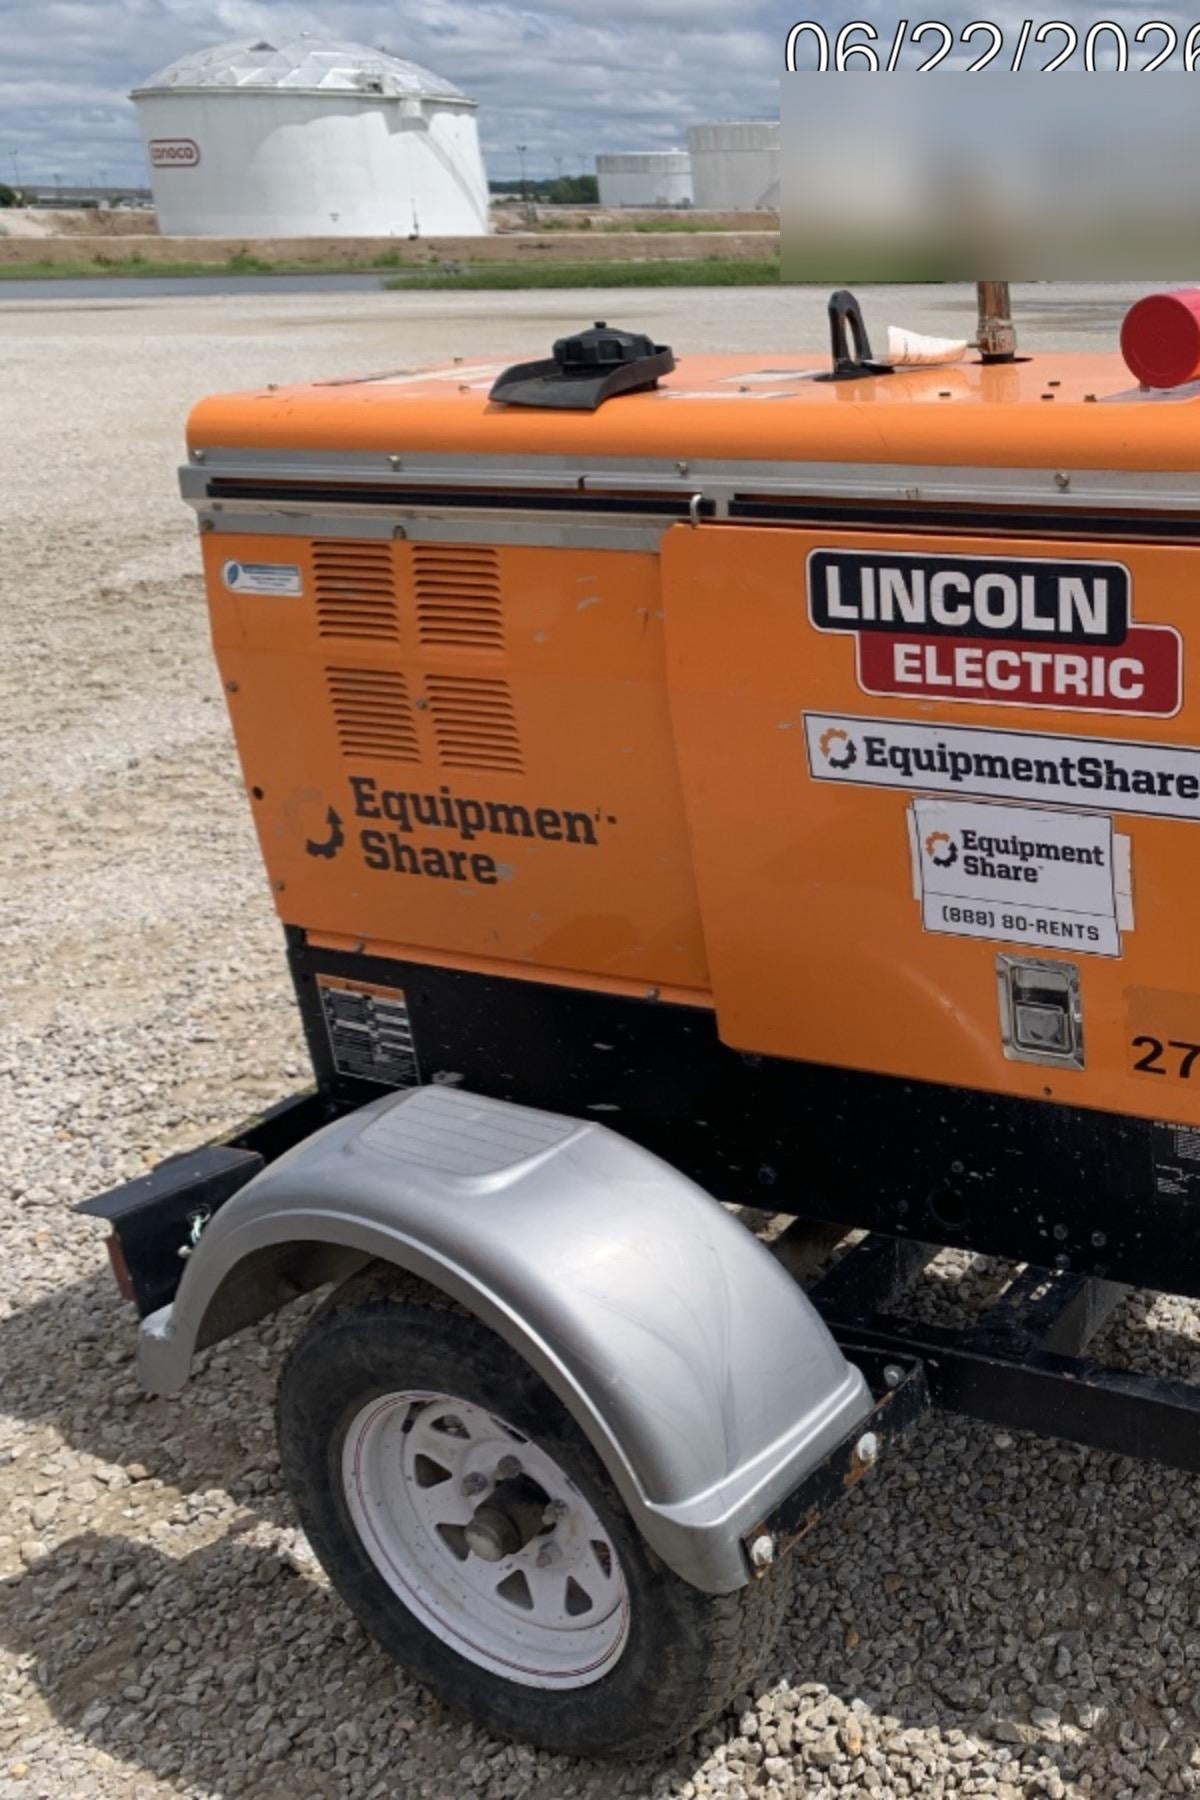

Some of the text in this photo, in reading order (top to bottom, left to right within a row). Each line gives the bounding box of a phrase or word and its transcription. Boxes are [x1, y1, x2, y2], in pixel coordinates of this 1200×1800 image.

[825, 565, 1108, 635] LINCOLN
[893, 643, 1145, 700] ELECTRIC
[863, 736, 1200, 799] EquipmentShare
[348, 775, 617, 846] Equipmen
[359, 829, 499, 885] Share
[960, 829, 1104, 866] Equipment
[963, 855, 1038, 883] Share
[942, 905, 1099, 941] (888) 80-RENTS
